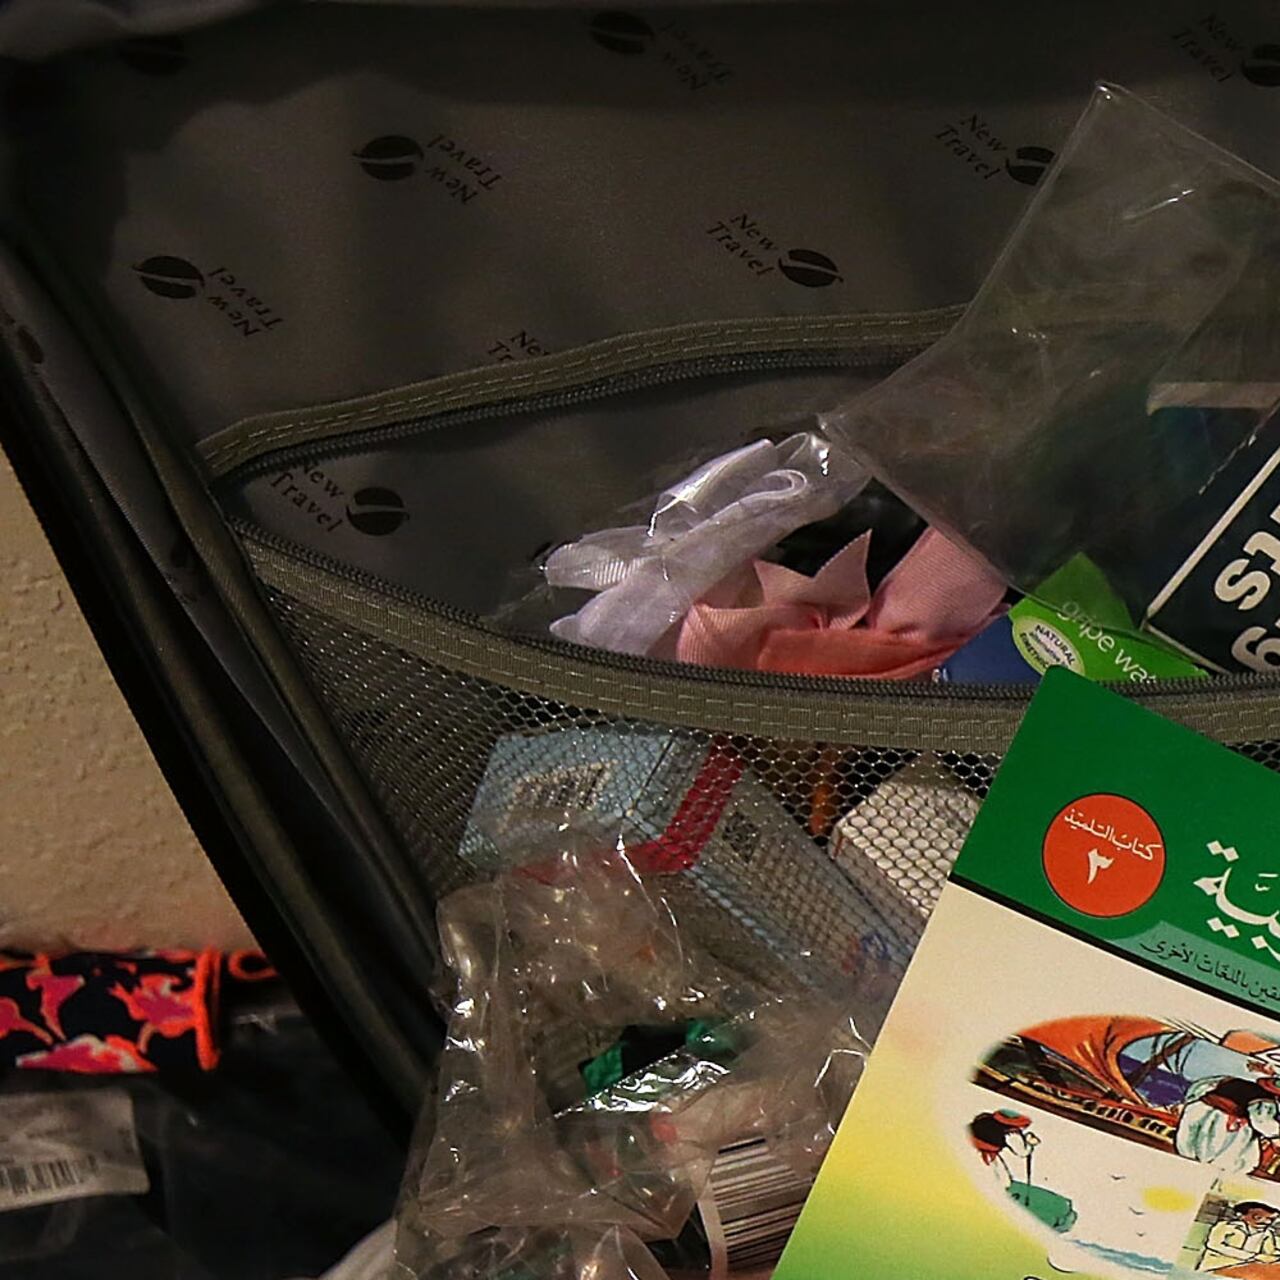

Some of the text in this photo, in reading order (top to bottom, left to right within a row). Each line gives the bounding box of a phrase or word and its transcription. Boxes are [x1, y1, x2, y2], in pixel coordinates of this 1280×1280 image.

[935, 125, 1001, 181] Travel
[960, 114, 1008, 151] New
[425, 166, 478, 204] New
[426, 134, 500, 191] Travel
[707, 221, 774, 277] Travel
[730, 213, 779, 251] New
[207, 295, 260, 337] New
[208, 267, 282, 330] Travel
[1035, 624, 1076, 666] NATURAL
[1056, 601, 1115, 652] gripe
